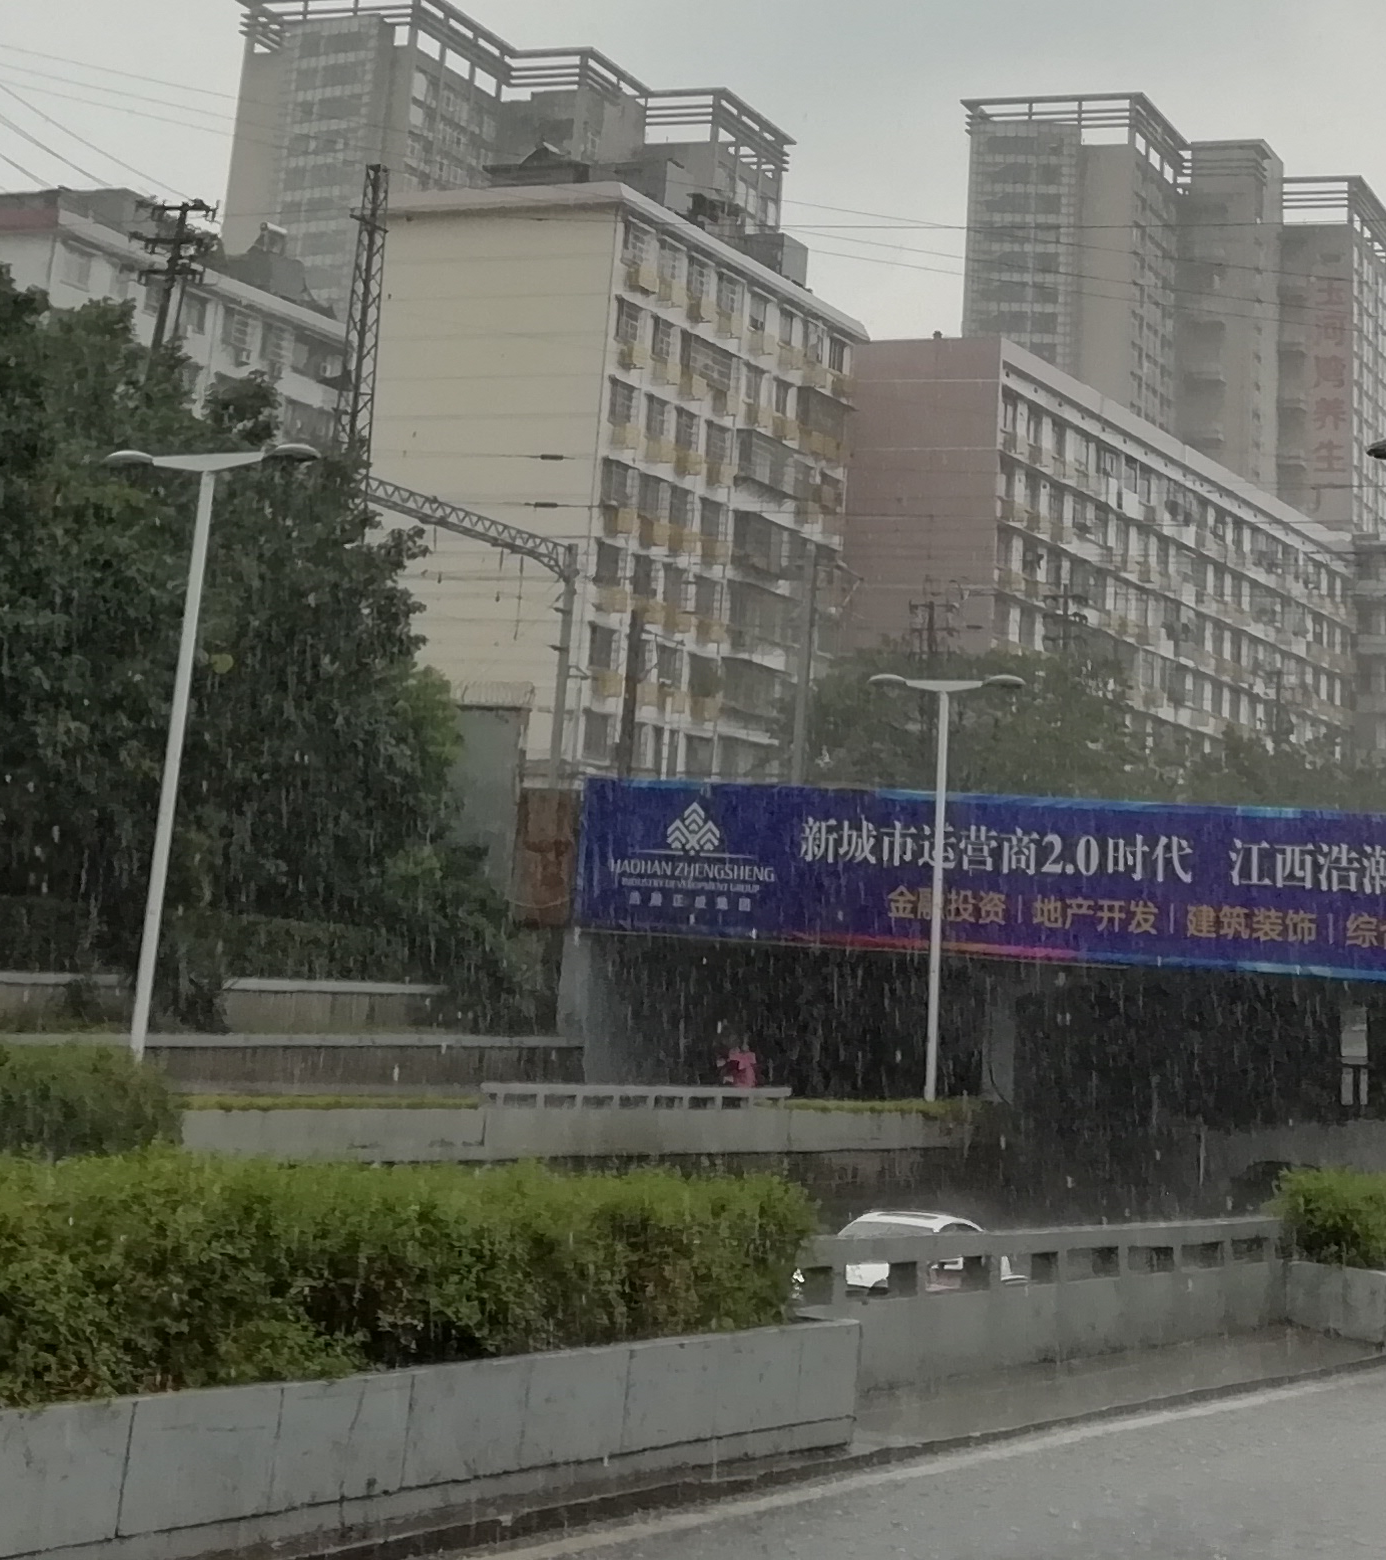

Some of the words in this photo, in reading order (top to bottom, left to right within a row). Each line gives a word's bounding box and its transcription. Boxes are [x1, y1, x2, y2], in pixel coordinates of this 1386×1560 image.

[674, 862, 775, 882] ZHENGSHENG
[799, 816, 1193, 884] 新城市运营商2.0时代
[887, 884, 1007, 926] 金融投资
[1032, 895, 1158, 936] 地产开发
[1186, 905, 1317, 945] 建筑装饰
